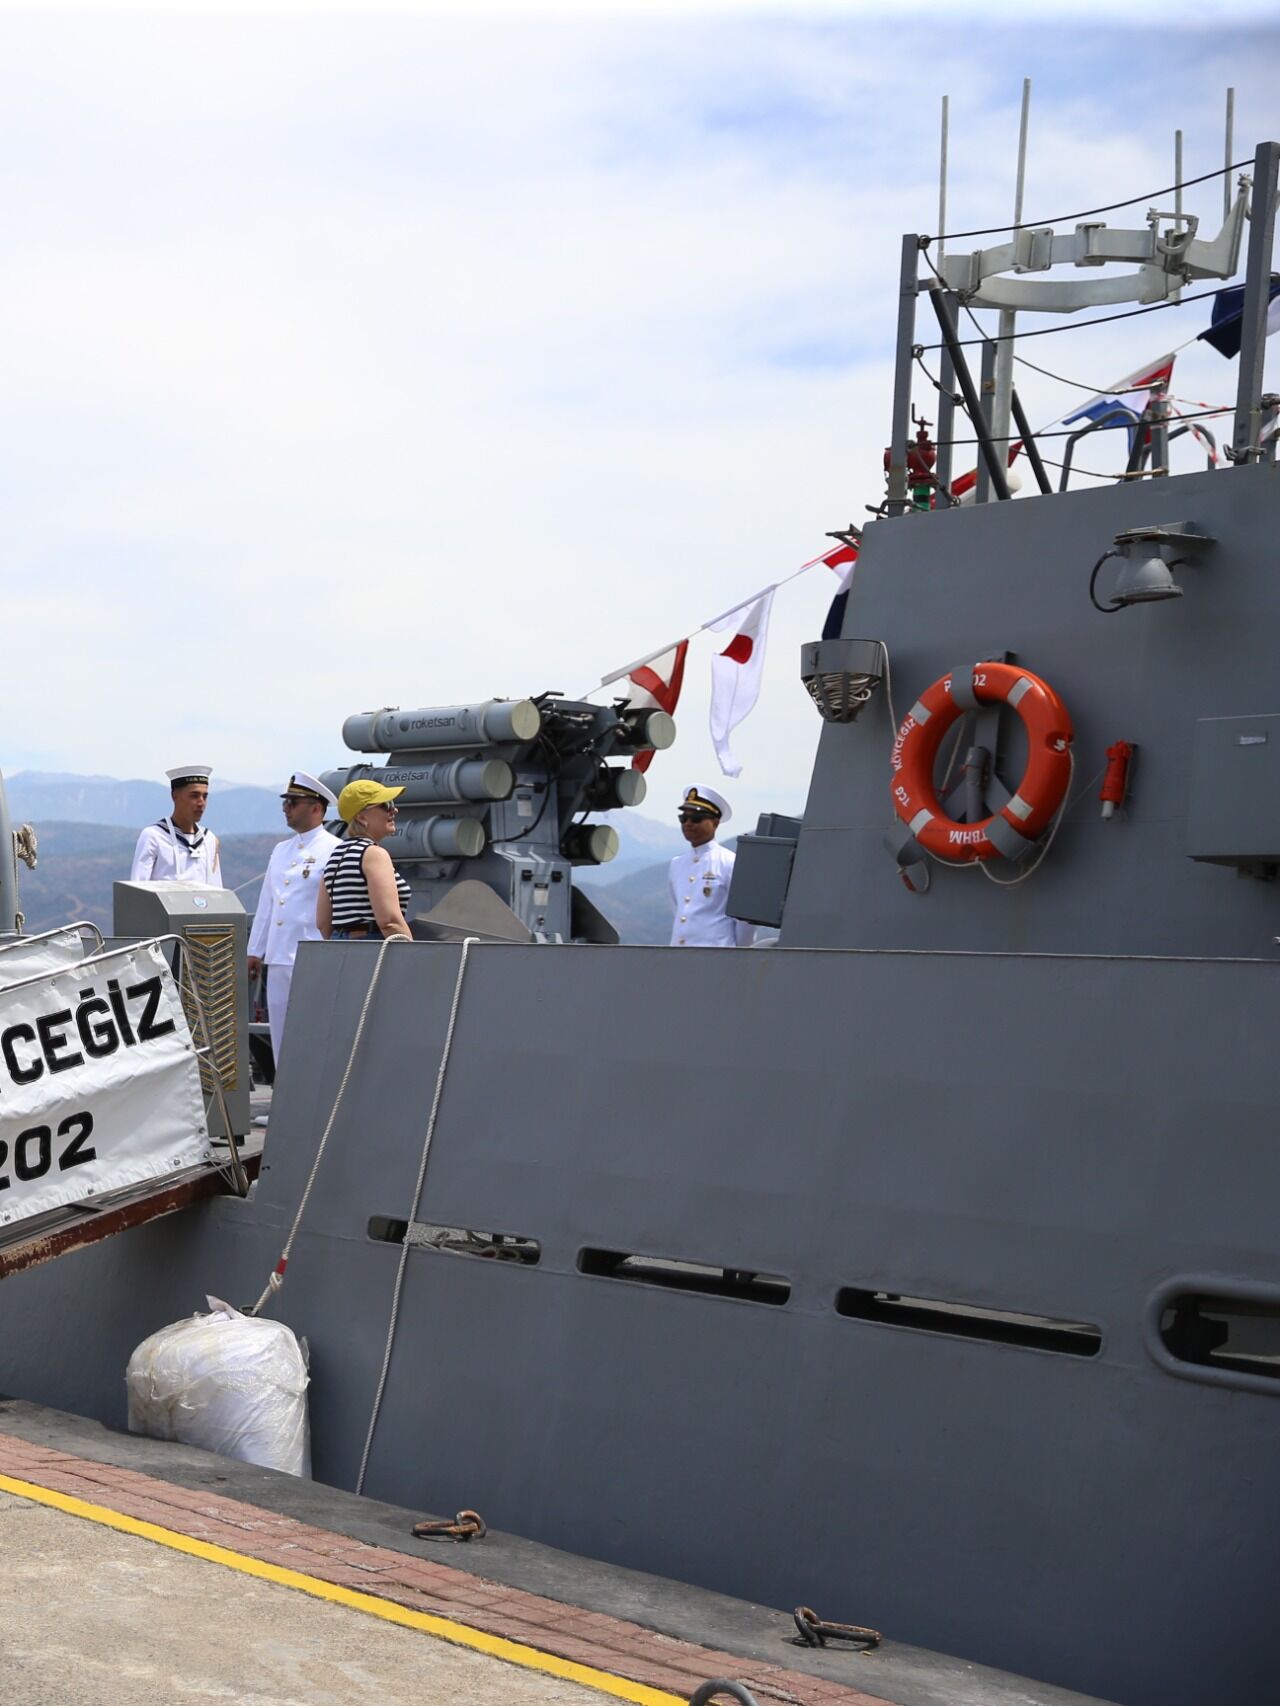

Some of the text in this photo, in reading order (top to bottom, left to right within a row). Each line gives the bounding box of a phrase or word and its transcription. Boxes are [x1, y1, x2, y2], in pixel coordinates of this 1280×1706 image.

[410, 716, 456, 730] roketsan
[384, 770, 430, 783] roketsan
[894, 785, 911, 808] TCG
